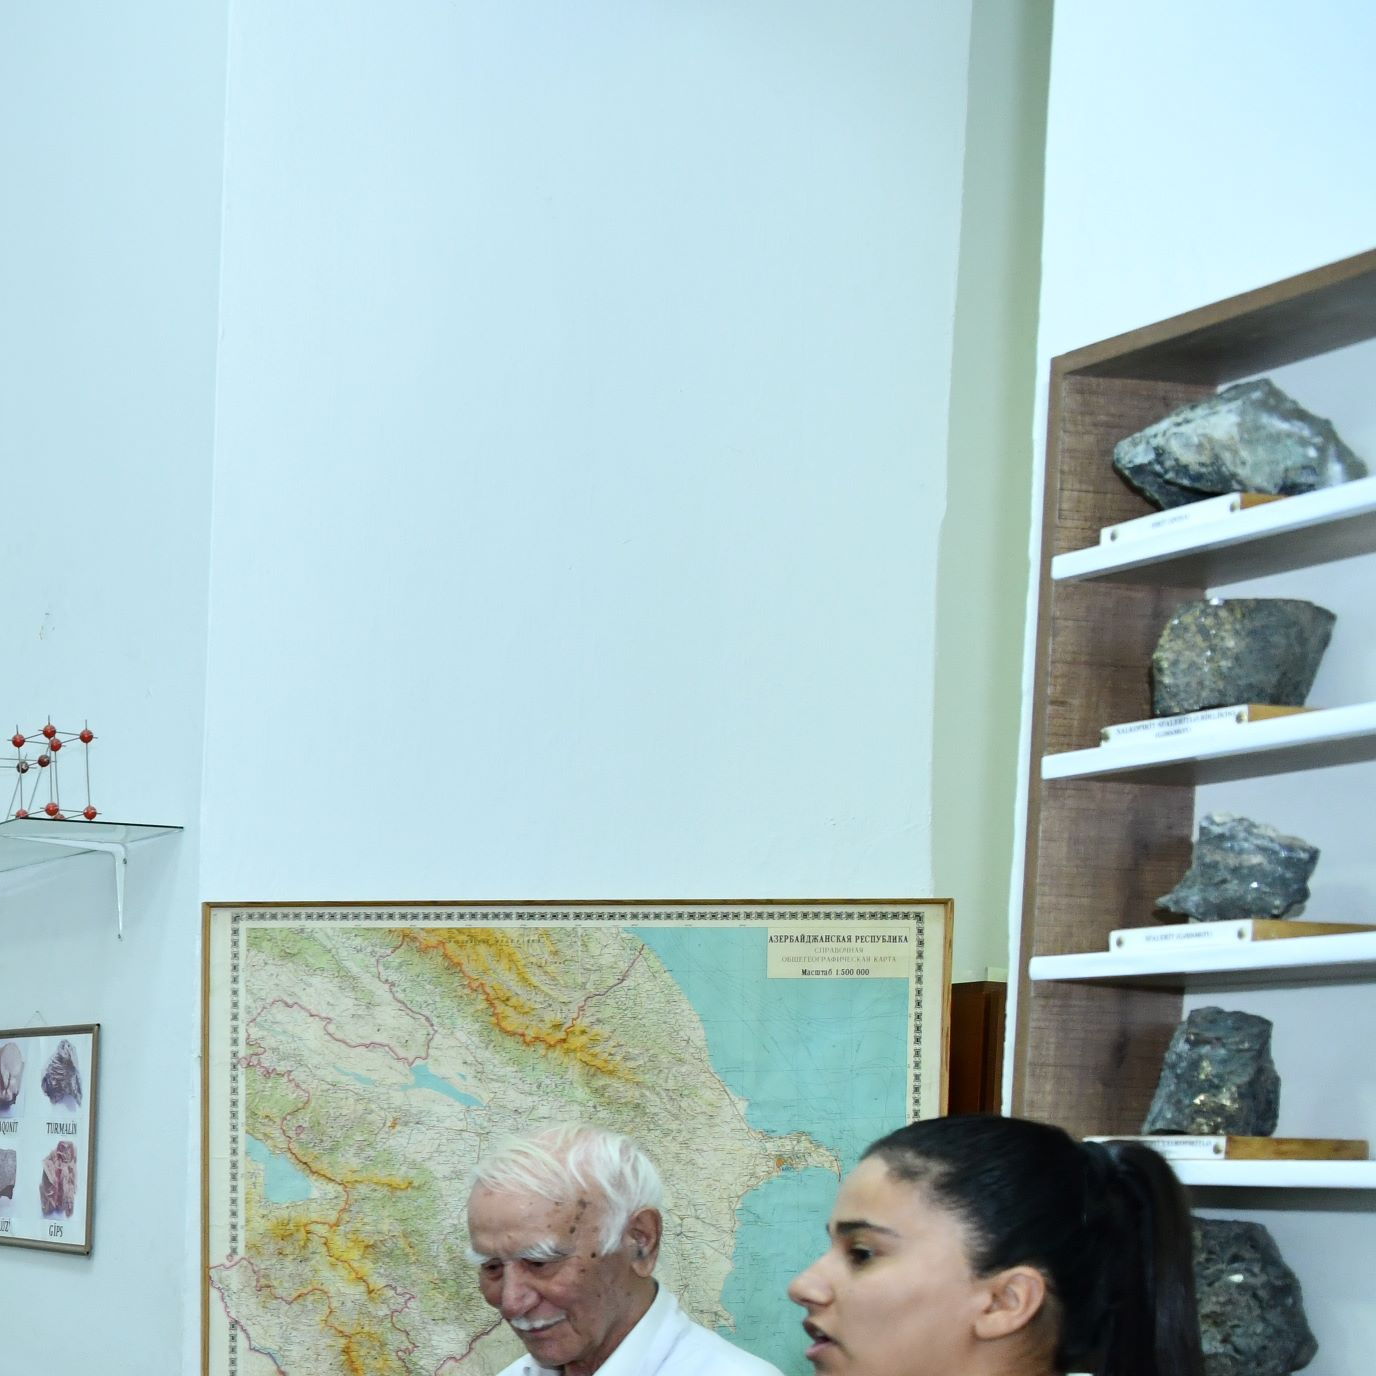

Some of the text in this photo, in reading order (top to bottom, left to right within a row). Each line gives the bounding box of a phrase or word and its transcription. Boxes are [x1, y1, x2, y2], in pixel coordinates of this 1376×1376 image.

[768, 933, 908, 944] АЗЕРБАЙДЖАНСКАЯ РЕСПУБЛИКА
[801, 968, 833, 976] Масштаб
[48, 1222, 64, 1238] GİPS
